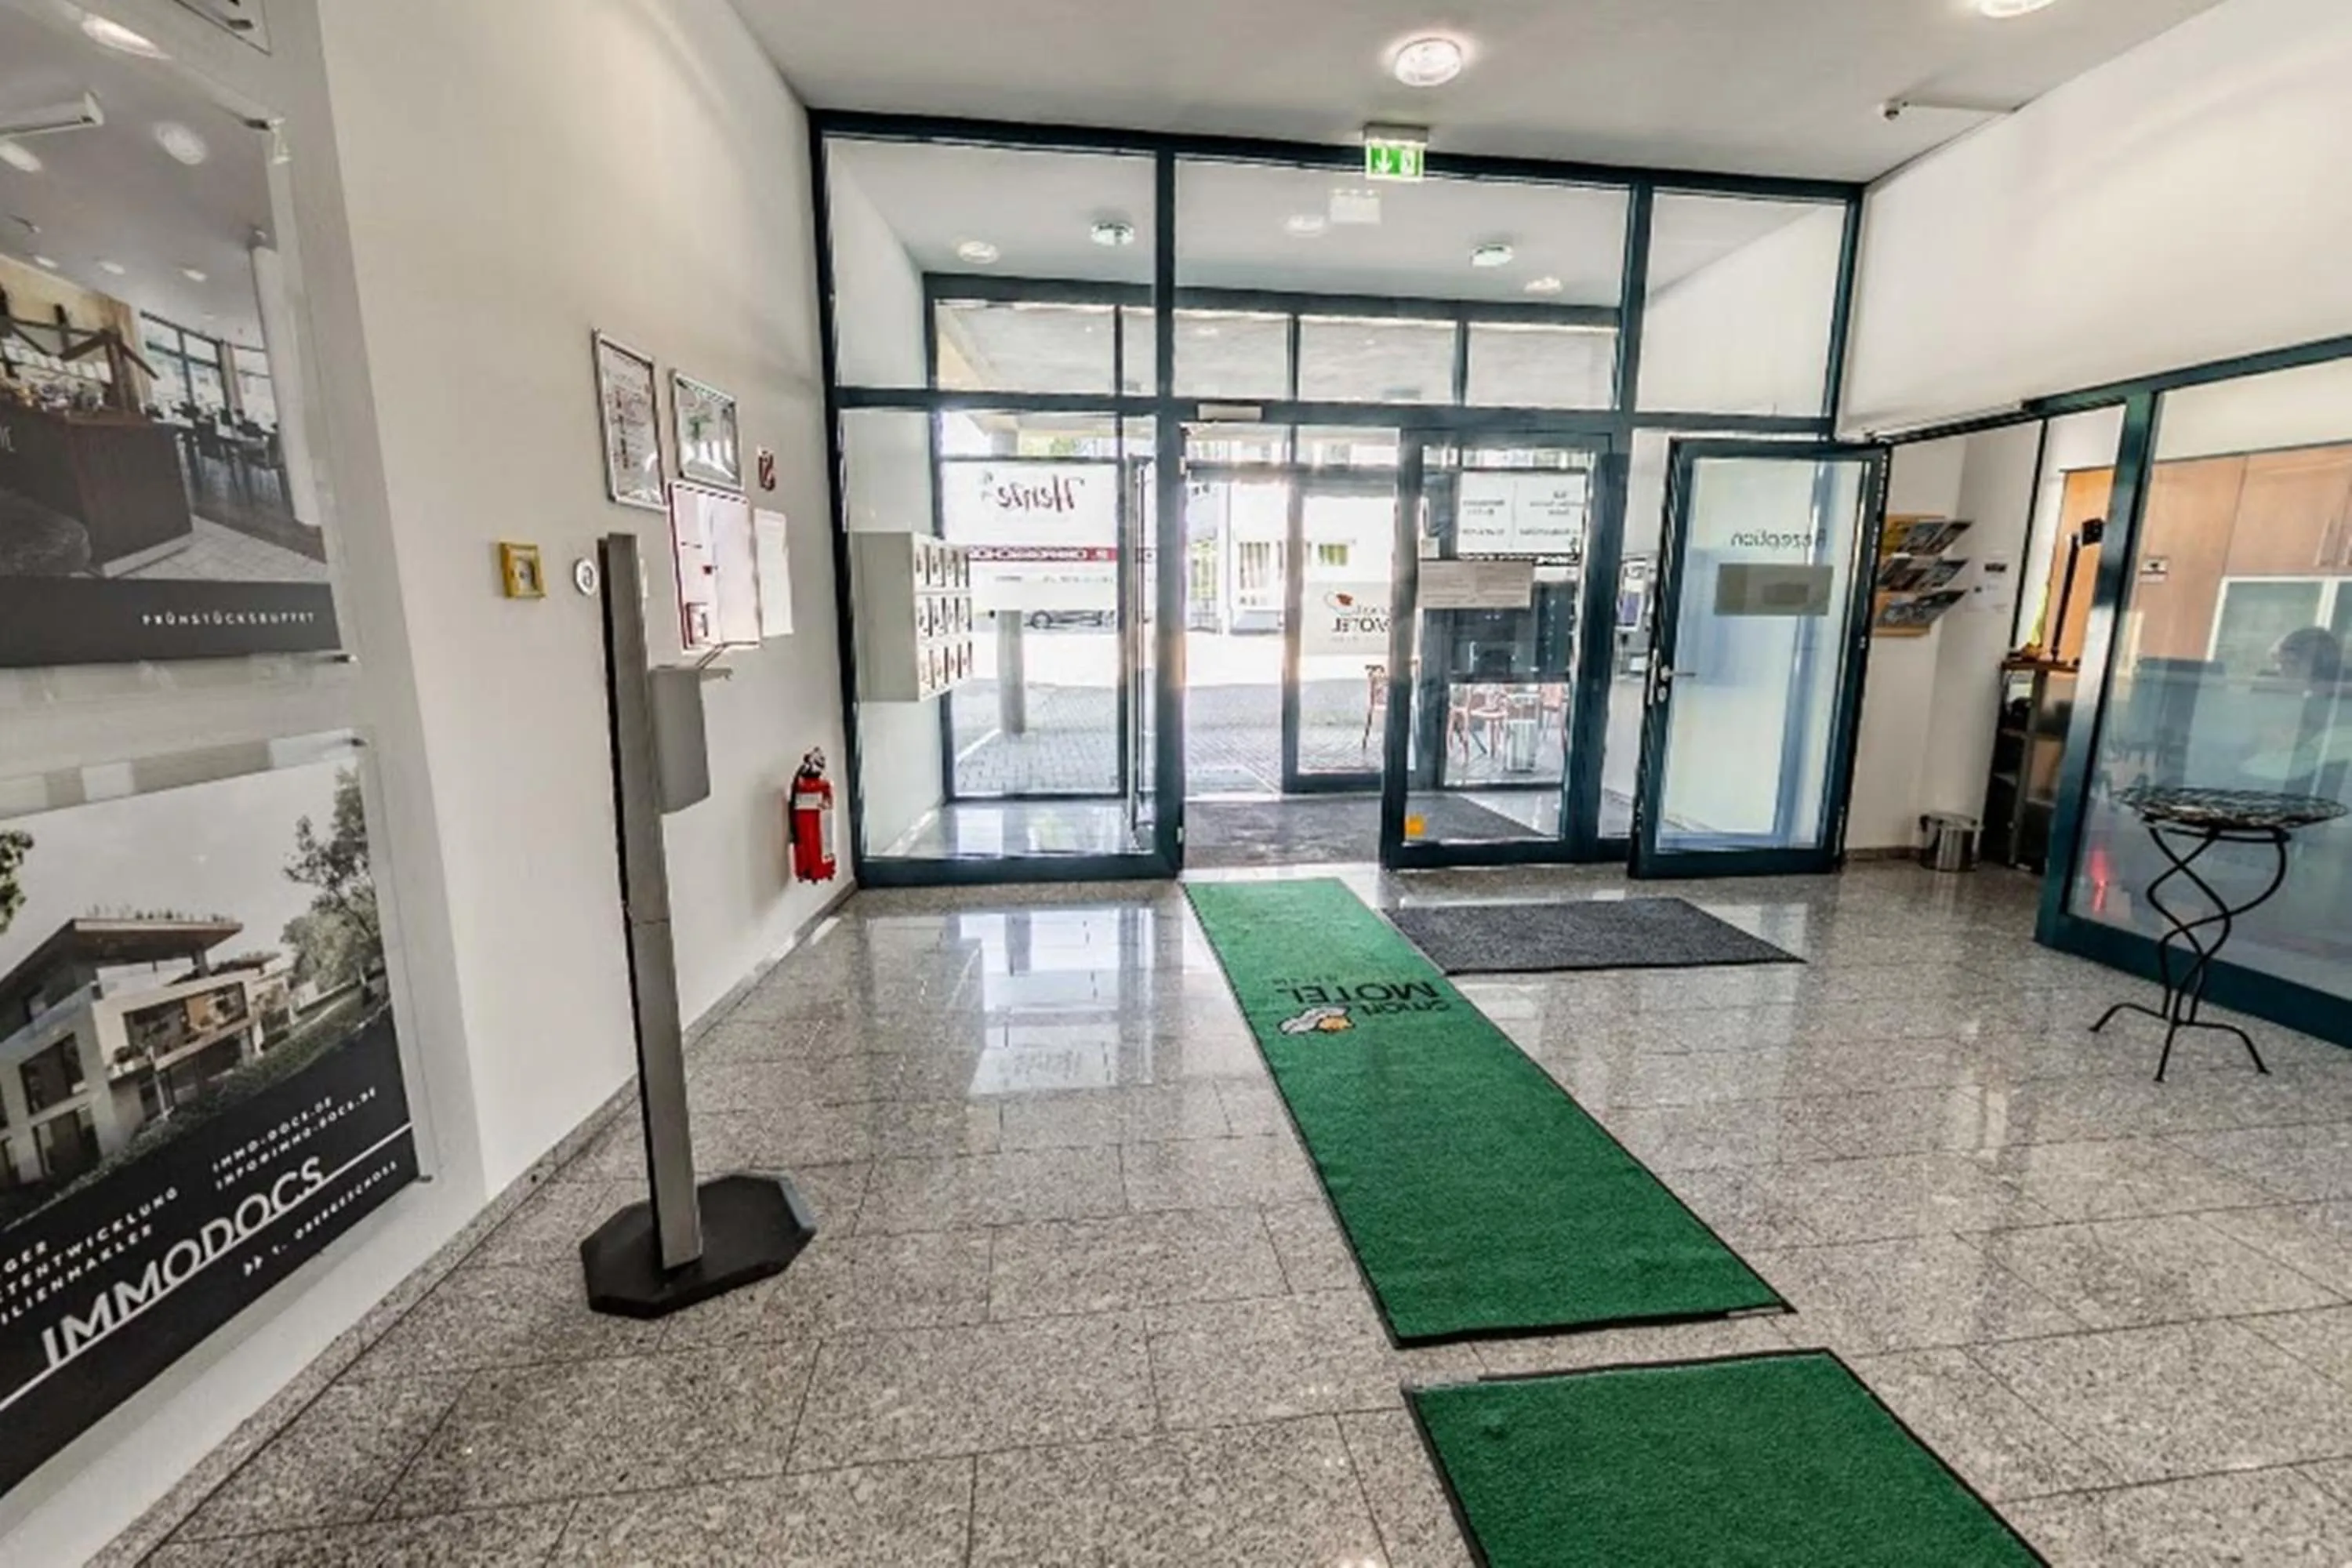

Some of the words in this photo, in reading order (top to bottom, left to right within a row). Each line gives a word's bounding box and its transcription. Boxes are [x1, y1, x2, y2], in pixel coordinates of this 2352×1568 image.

[1276, 981, 1440, 1004] MOTEL
[0, 1186, 179, 1302] TENTWICKLUNG
[41, 1156, 327, 1368] IMMODOCS
